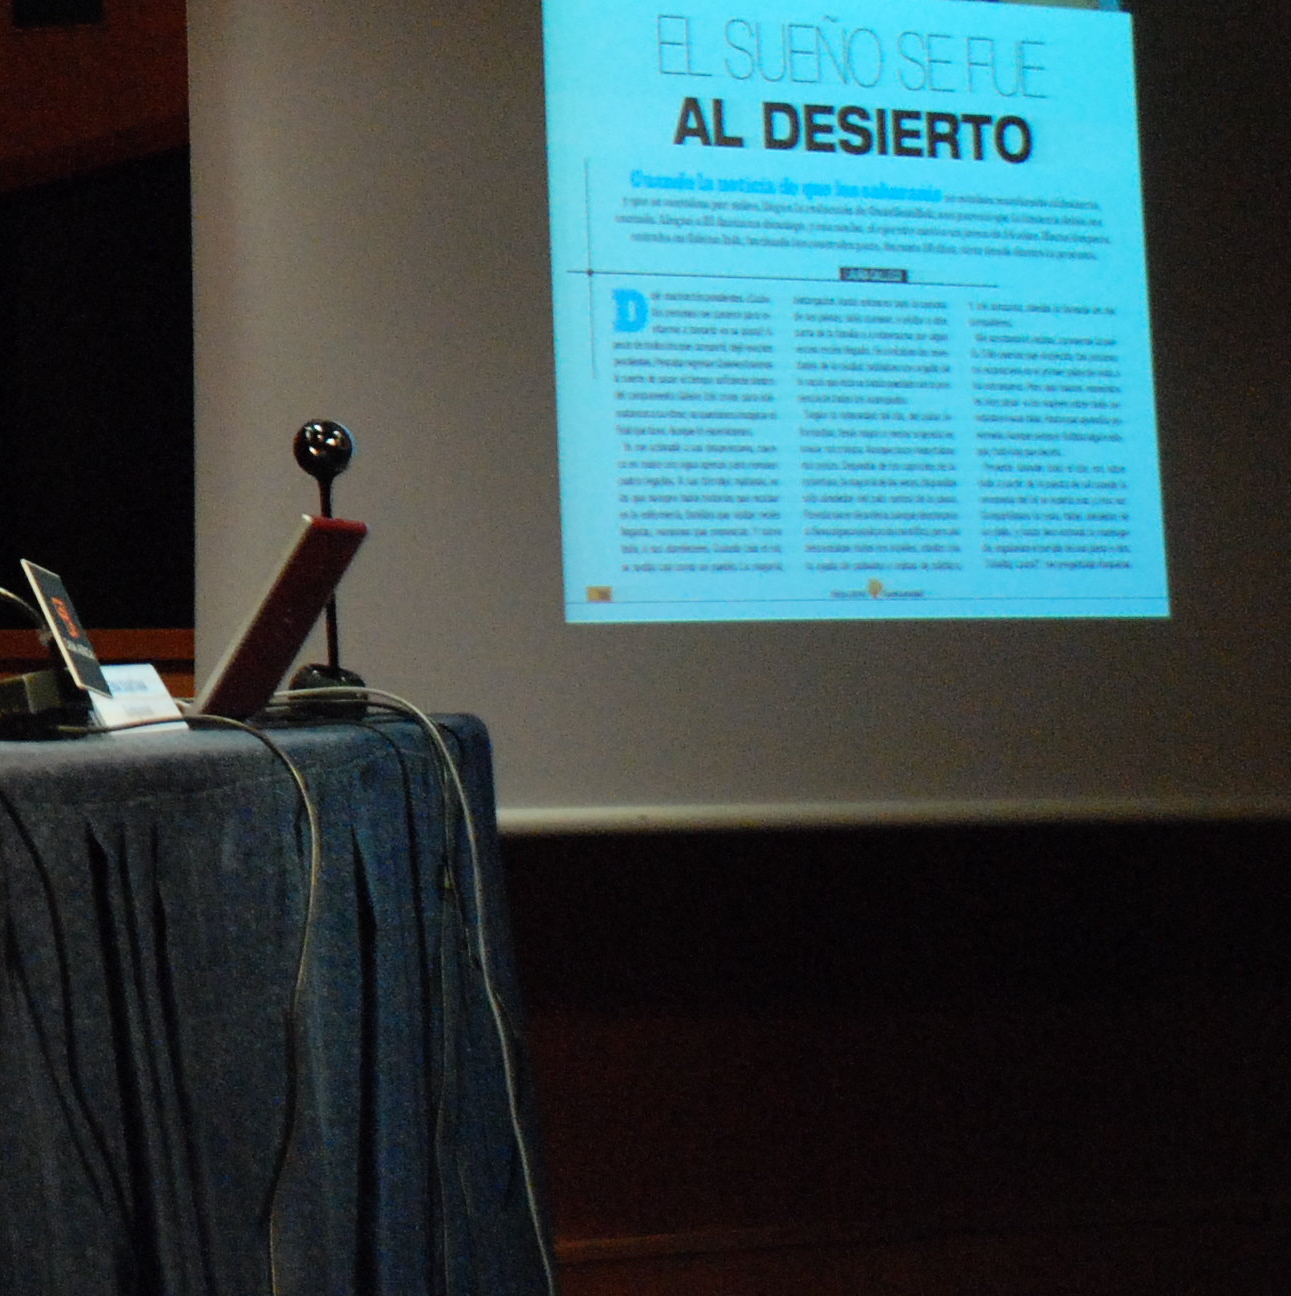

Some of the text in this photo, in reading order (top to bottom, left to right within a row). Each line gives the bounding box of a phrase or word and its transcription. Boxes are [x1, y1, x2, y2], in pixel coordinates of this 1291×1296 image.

[657, 14, 1047, 100] EL SUEÑO SE FUE
[672, 96, 1033, 165] AL DESIERTO
